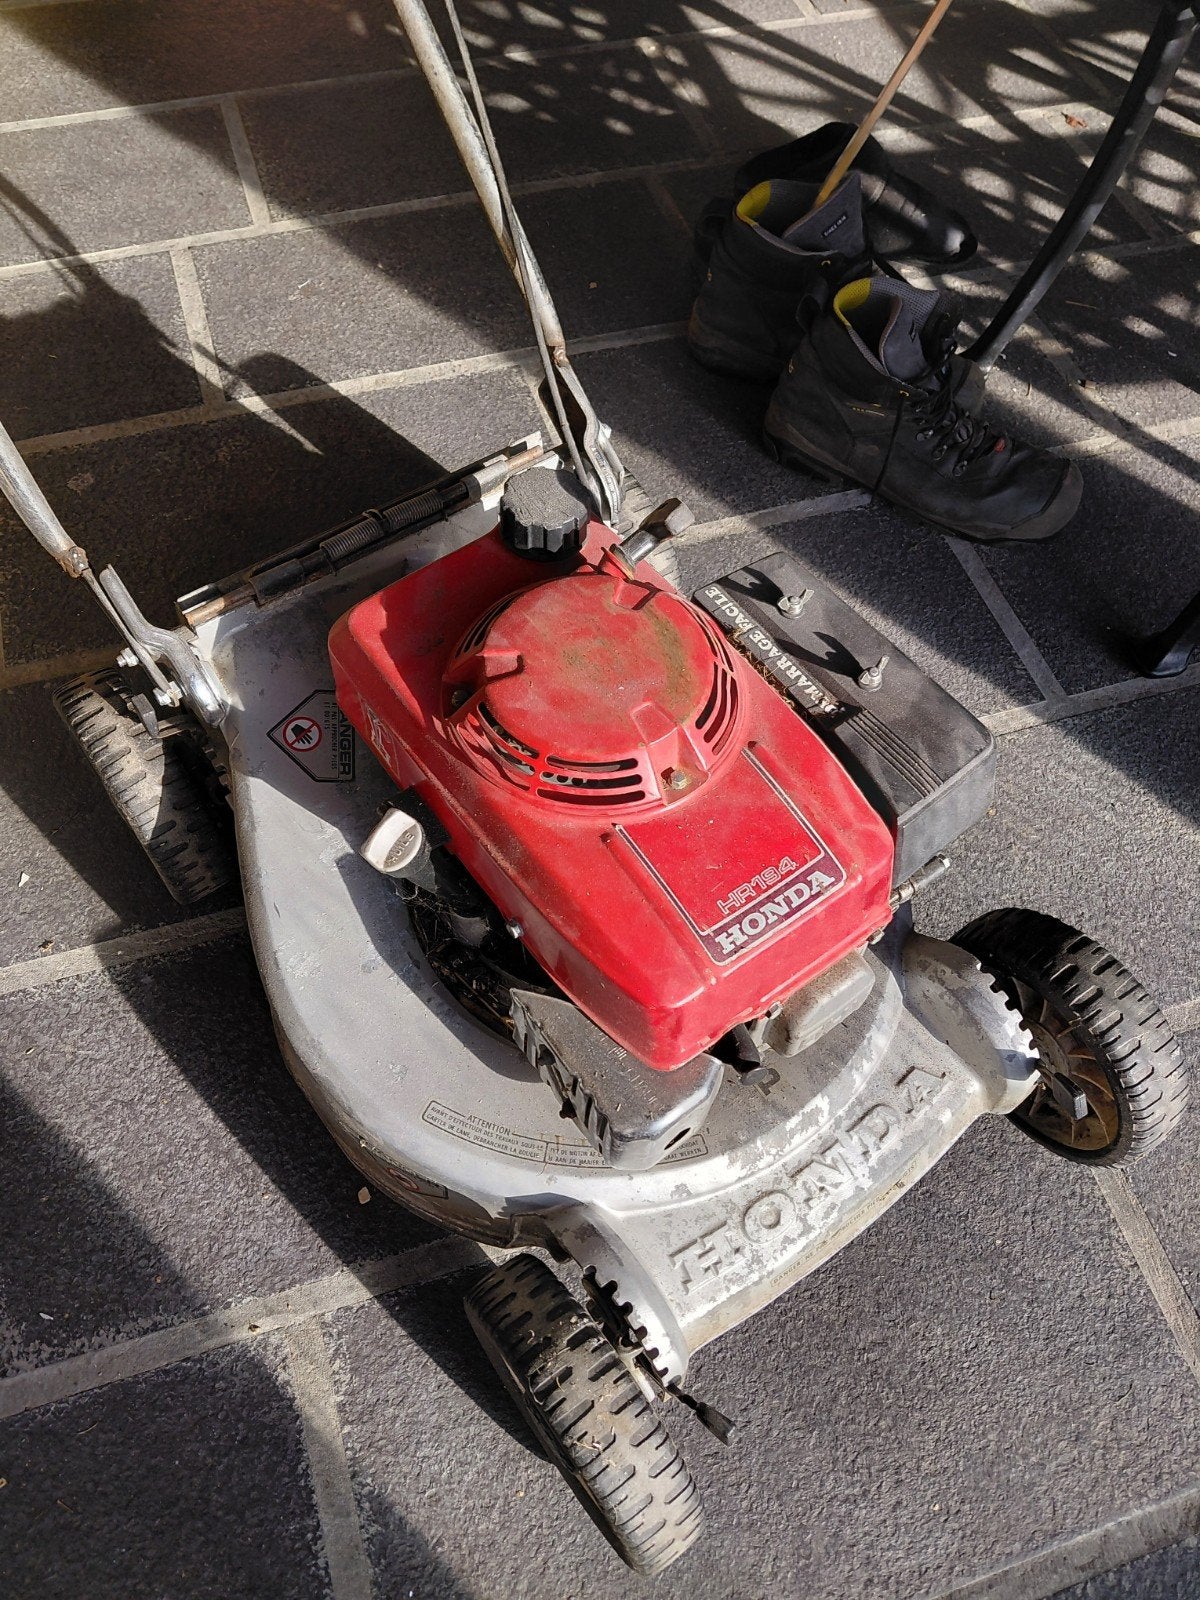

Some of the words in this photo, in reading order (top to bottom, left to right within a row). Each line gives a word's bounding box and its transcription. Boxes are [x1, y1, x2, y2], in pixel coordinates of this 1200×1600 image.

[704, 586, 755, 634] FACILE
[339, 708, 352, 776] ANGER
[716, 856, 799, 915] HR194
[714, 870, 836, 955] HONDA
[426, 1113, 447, 1126] CARTER
[509, 1146, 517, 1154] LA
[430, 1106, 449, 1118] AVANT
[483, 1129, 494, 1138] DES
[495, 1134, 519, 1146] TRAVAUX
[466, 1114, 512, 1136] ATTENTION
[668, 1064, 951, 1295] HONDA
